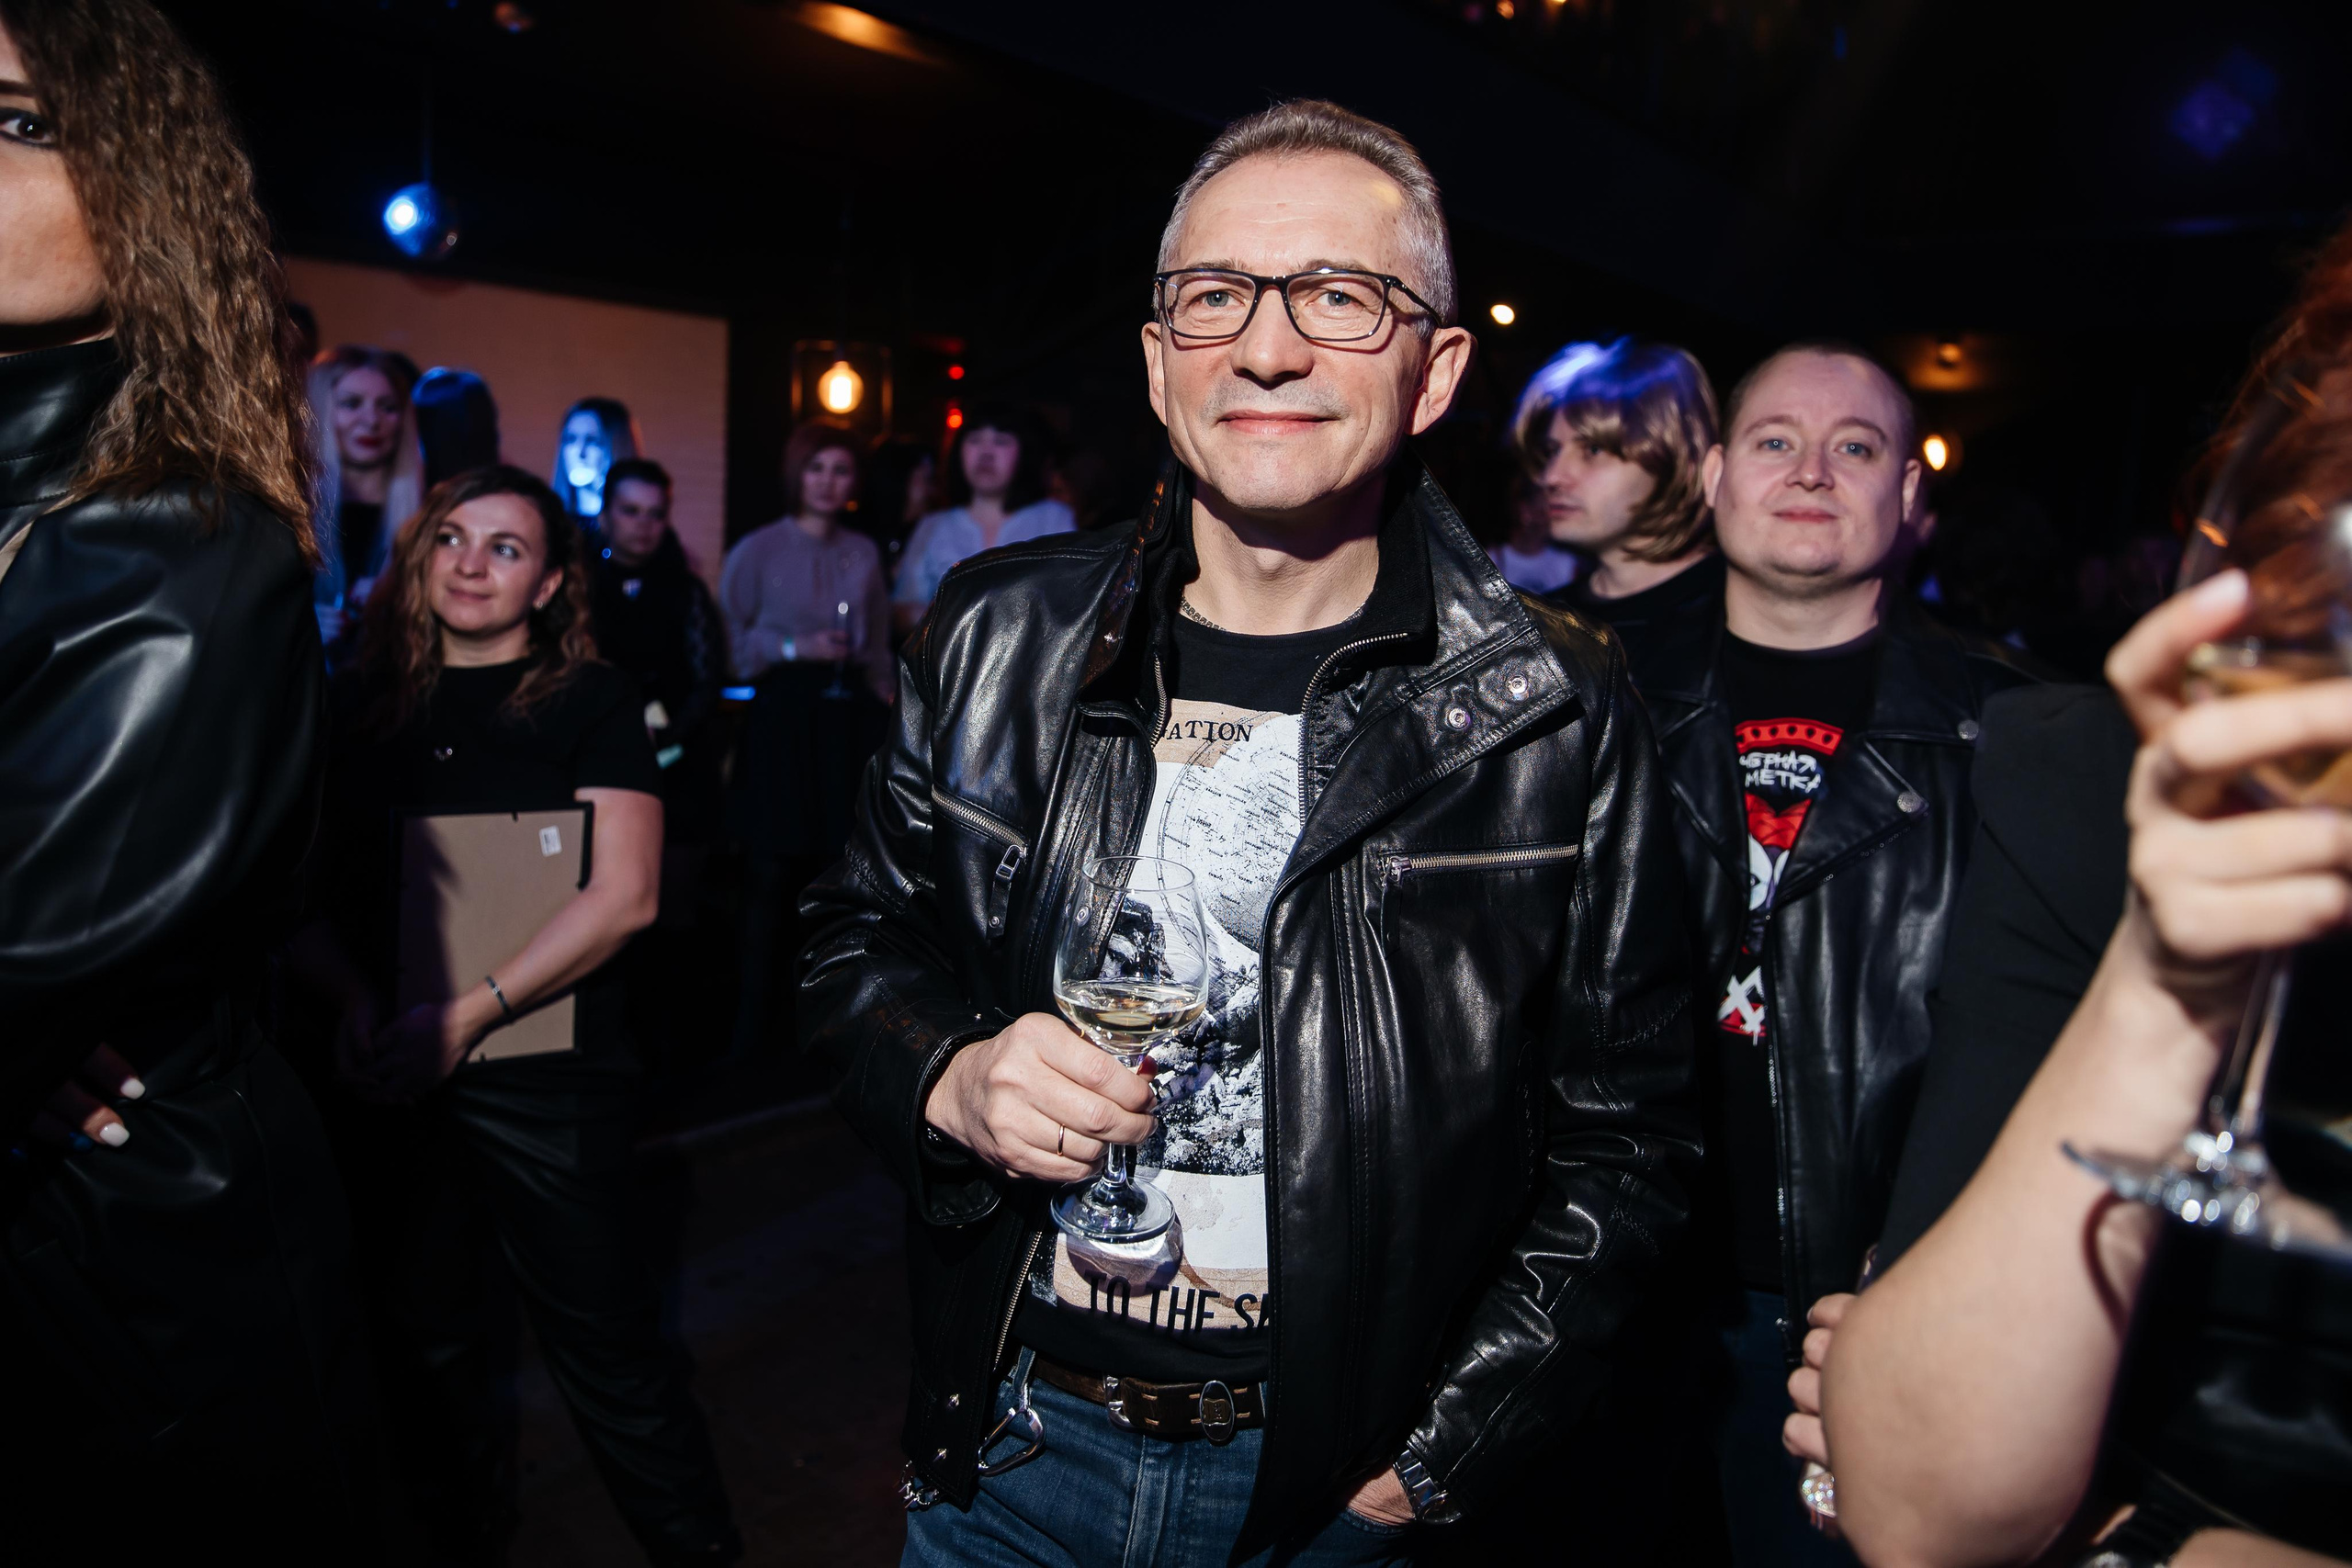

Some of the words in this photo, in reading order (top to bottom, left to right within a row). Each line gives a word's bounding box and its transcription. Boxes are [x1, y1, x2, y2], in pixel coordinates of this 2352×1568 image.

[1163, 720, 1254, 742] ATION
[1084, 1269, 1131, 1316] TO
[1146, 1280, 1220, 1332] THE
